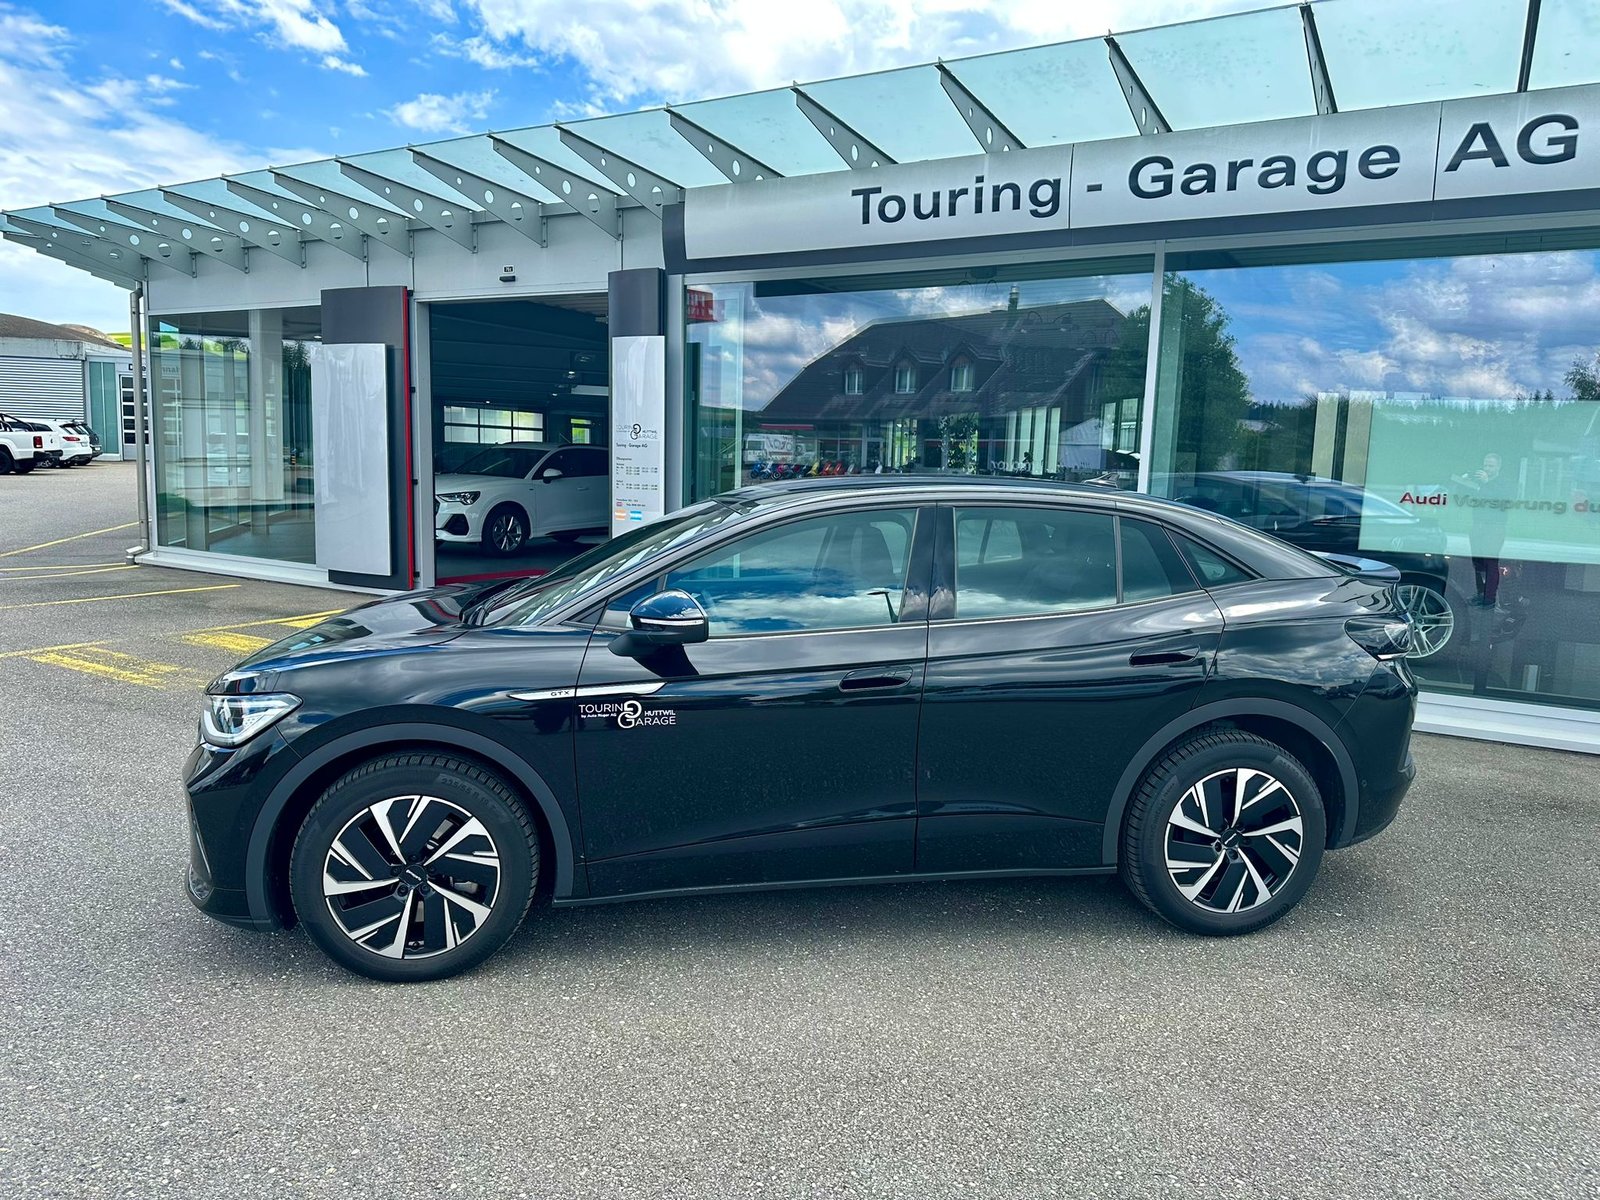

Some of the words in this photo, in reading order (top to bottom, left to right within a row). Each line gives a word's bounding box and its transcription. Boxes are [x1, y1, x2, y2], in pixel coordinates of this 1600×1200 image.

[851, 175, 1062, 225] Touring
[1128, 144, 1401, 199] Garage
[1444, 113, 1580, 172] AG
[1400, 491, 1447, 506] Audi
[1454, 493, 1567, 515] Vorsprung
[617, 711, 676, 729] GARAGE
[644, 709, 676, 717] HUTTWIL
